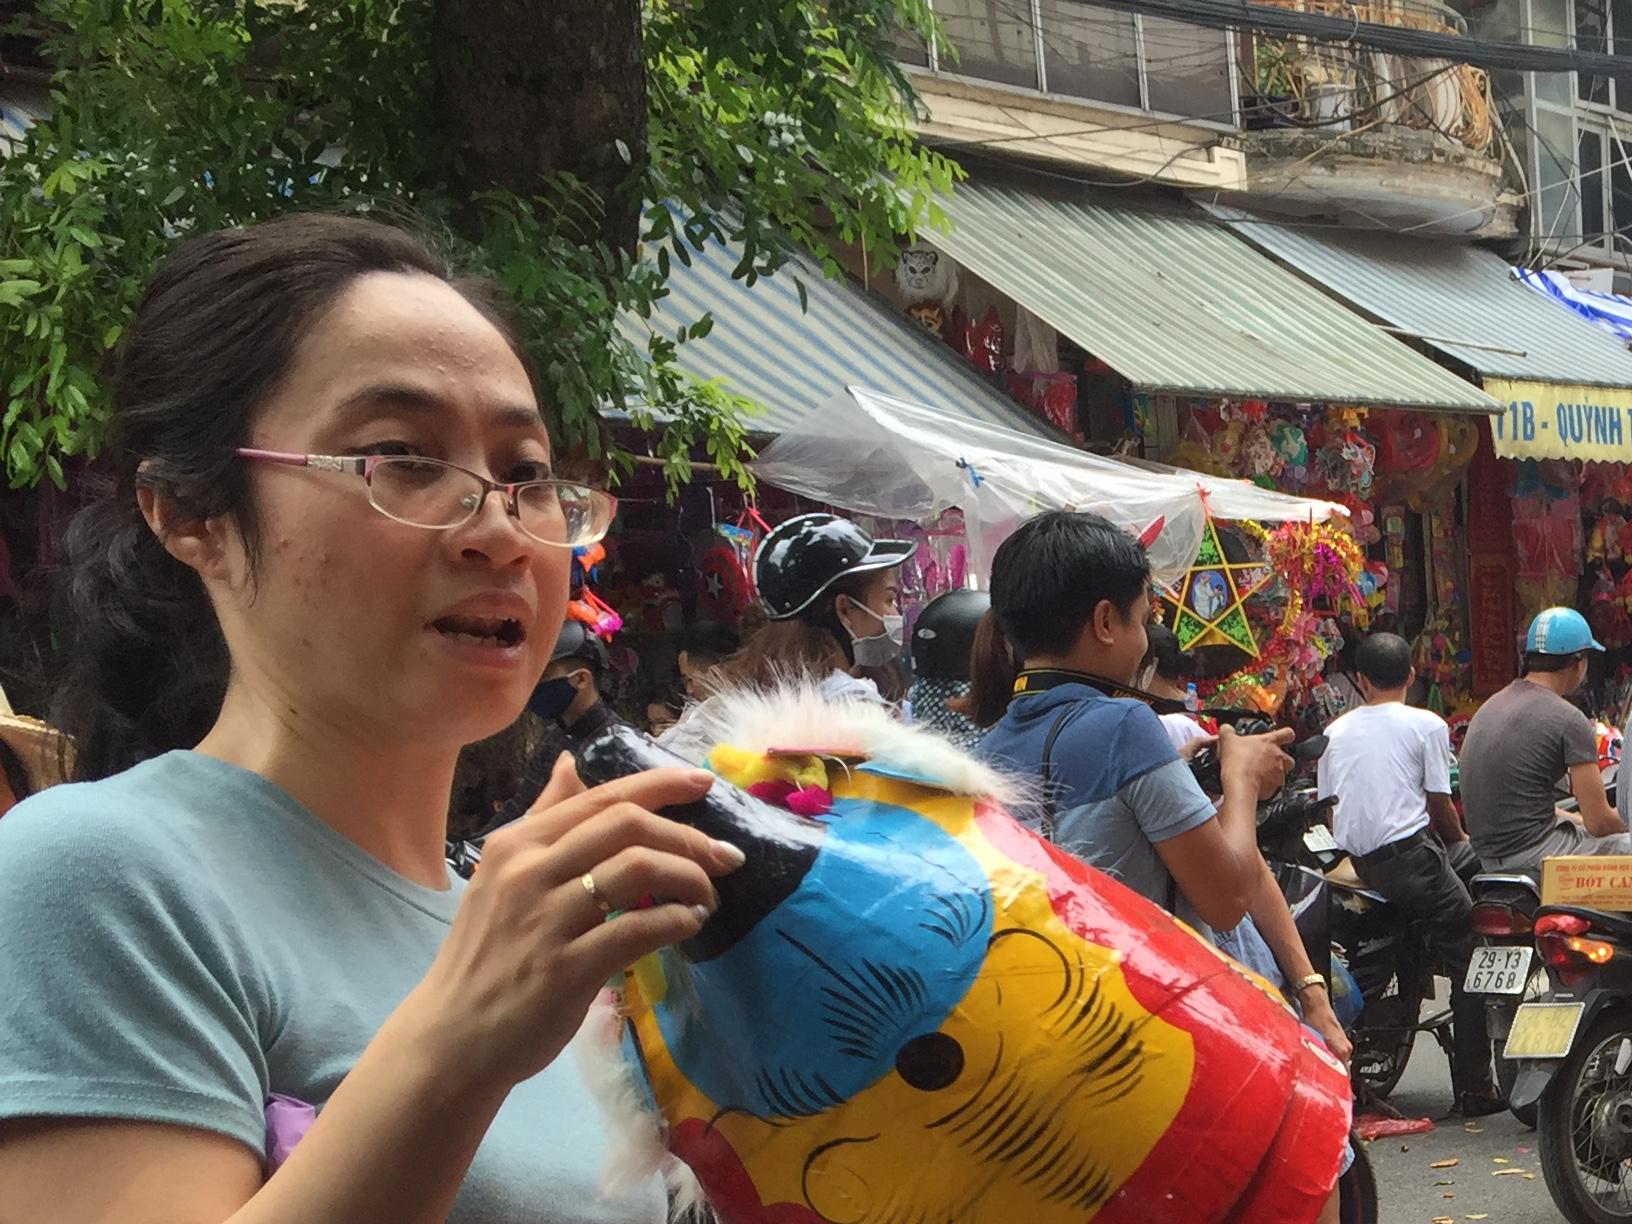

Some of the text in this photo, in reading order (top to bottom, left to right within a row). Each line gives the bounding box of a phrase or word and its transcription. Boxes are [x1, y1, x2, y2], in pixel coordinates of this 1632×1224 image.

[1556, 397, 1622, 447] QUỲNH
[1478, 951, 1521, 969] 29-Y3
[1473, 971, 1516, 989] 6768
